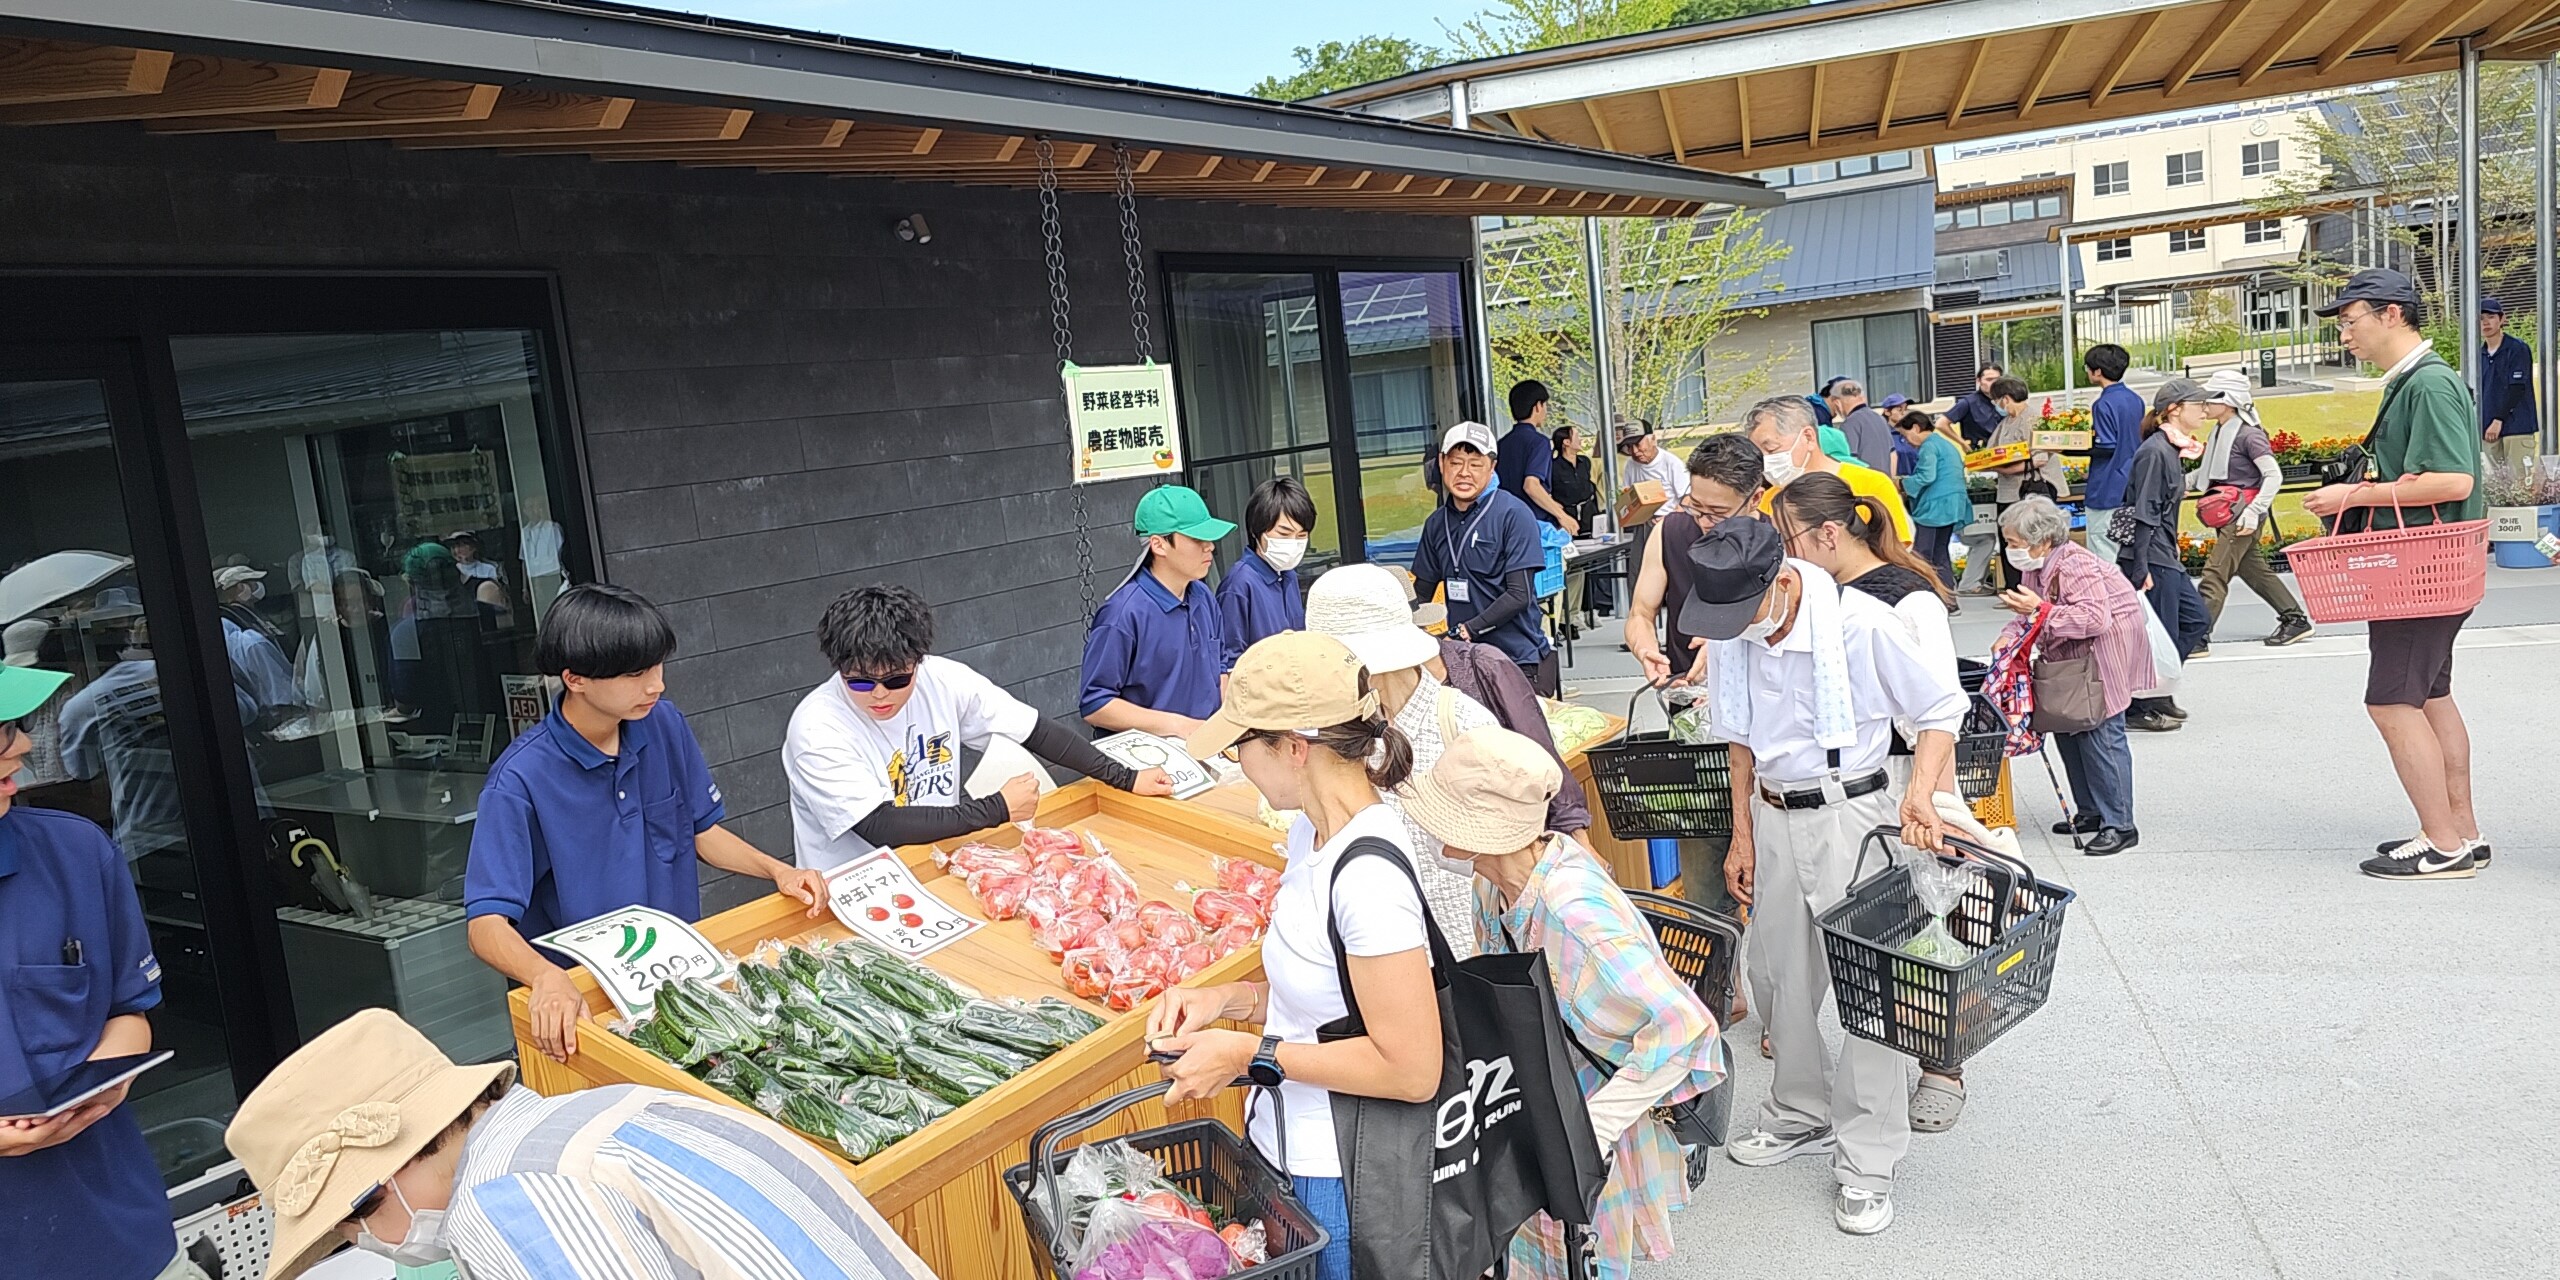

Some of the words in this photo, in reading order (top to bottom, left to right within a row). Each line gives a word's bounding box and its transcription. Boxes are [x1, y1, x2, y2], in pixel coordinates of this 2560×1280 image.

[1082, 389, 1159, 411] 野菜経営学科
[1088, 425, 1164, 452] 農産物販売
[513, 699, 537, 717] AED
[912, 771, 954, 801] ERS
[838, 870, 901, 907] 中玉トマト
[901, 917, 968, 949] 200円
[630, 954, 708, 991] 200円
[1484, 1100, 1522, 1130] RUN
